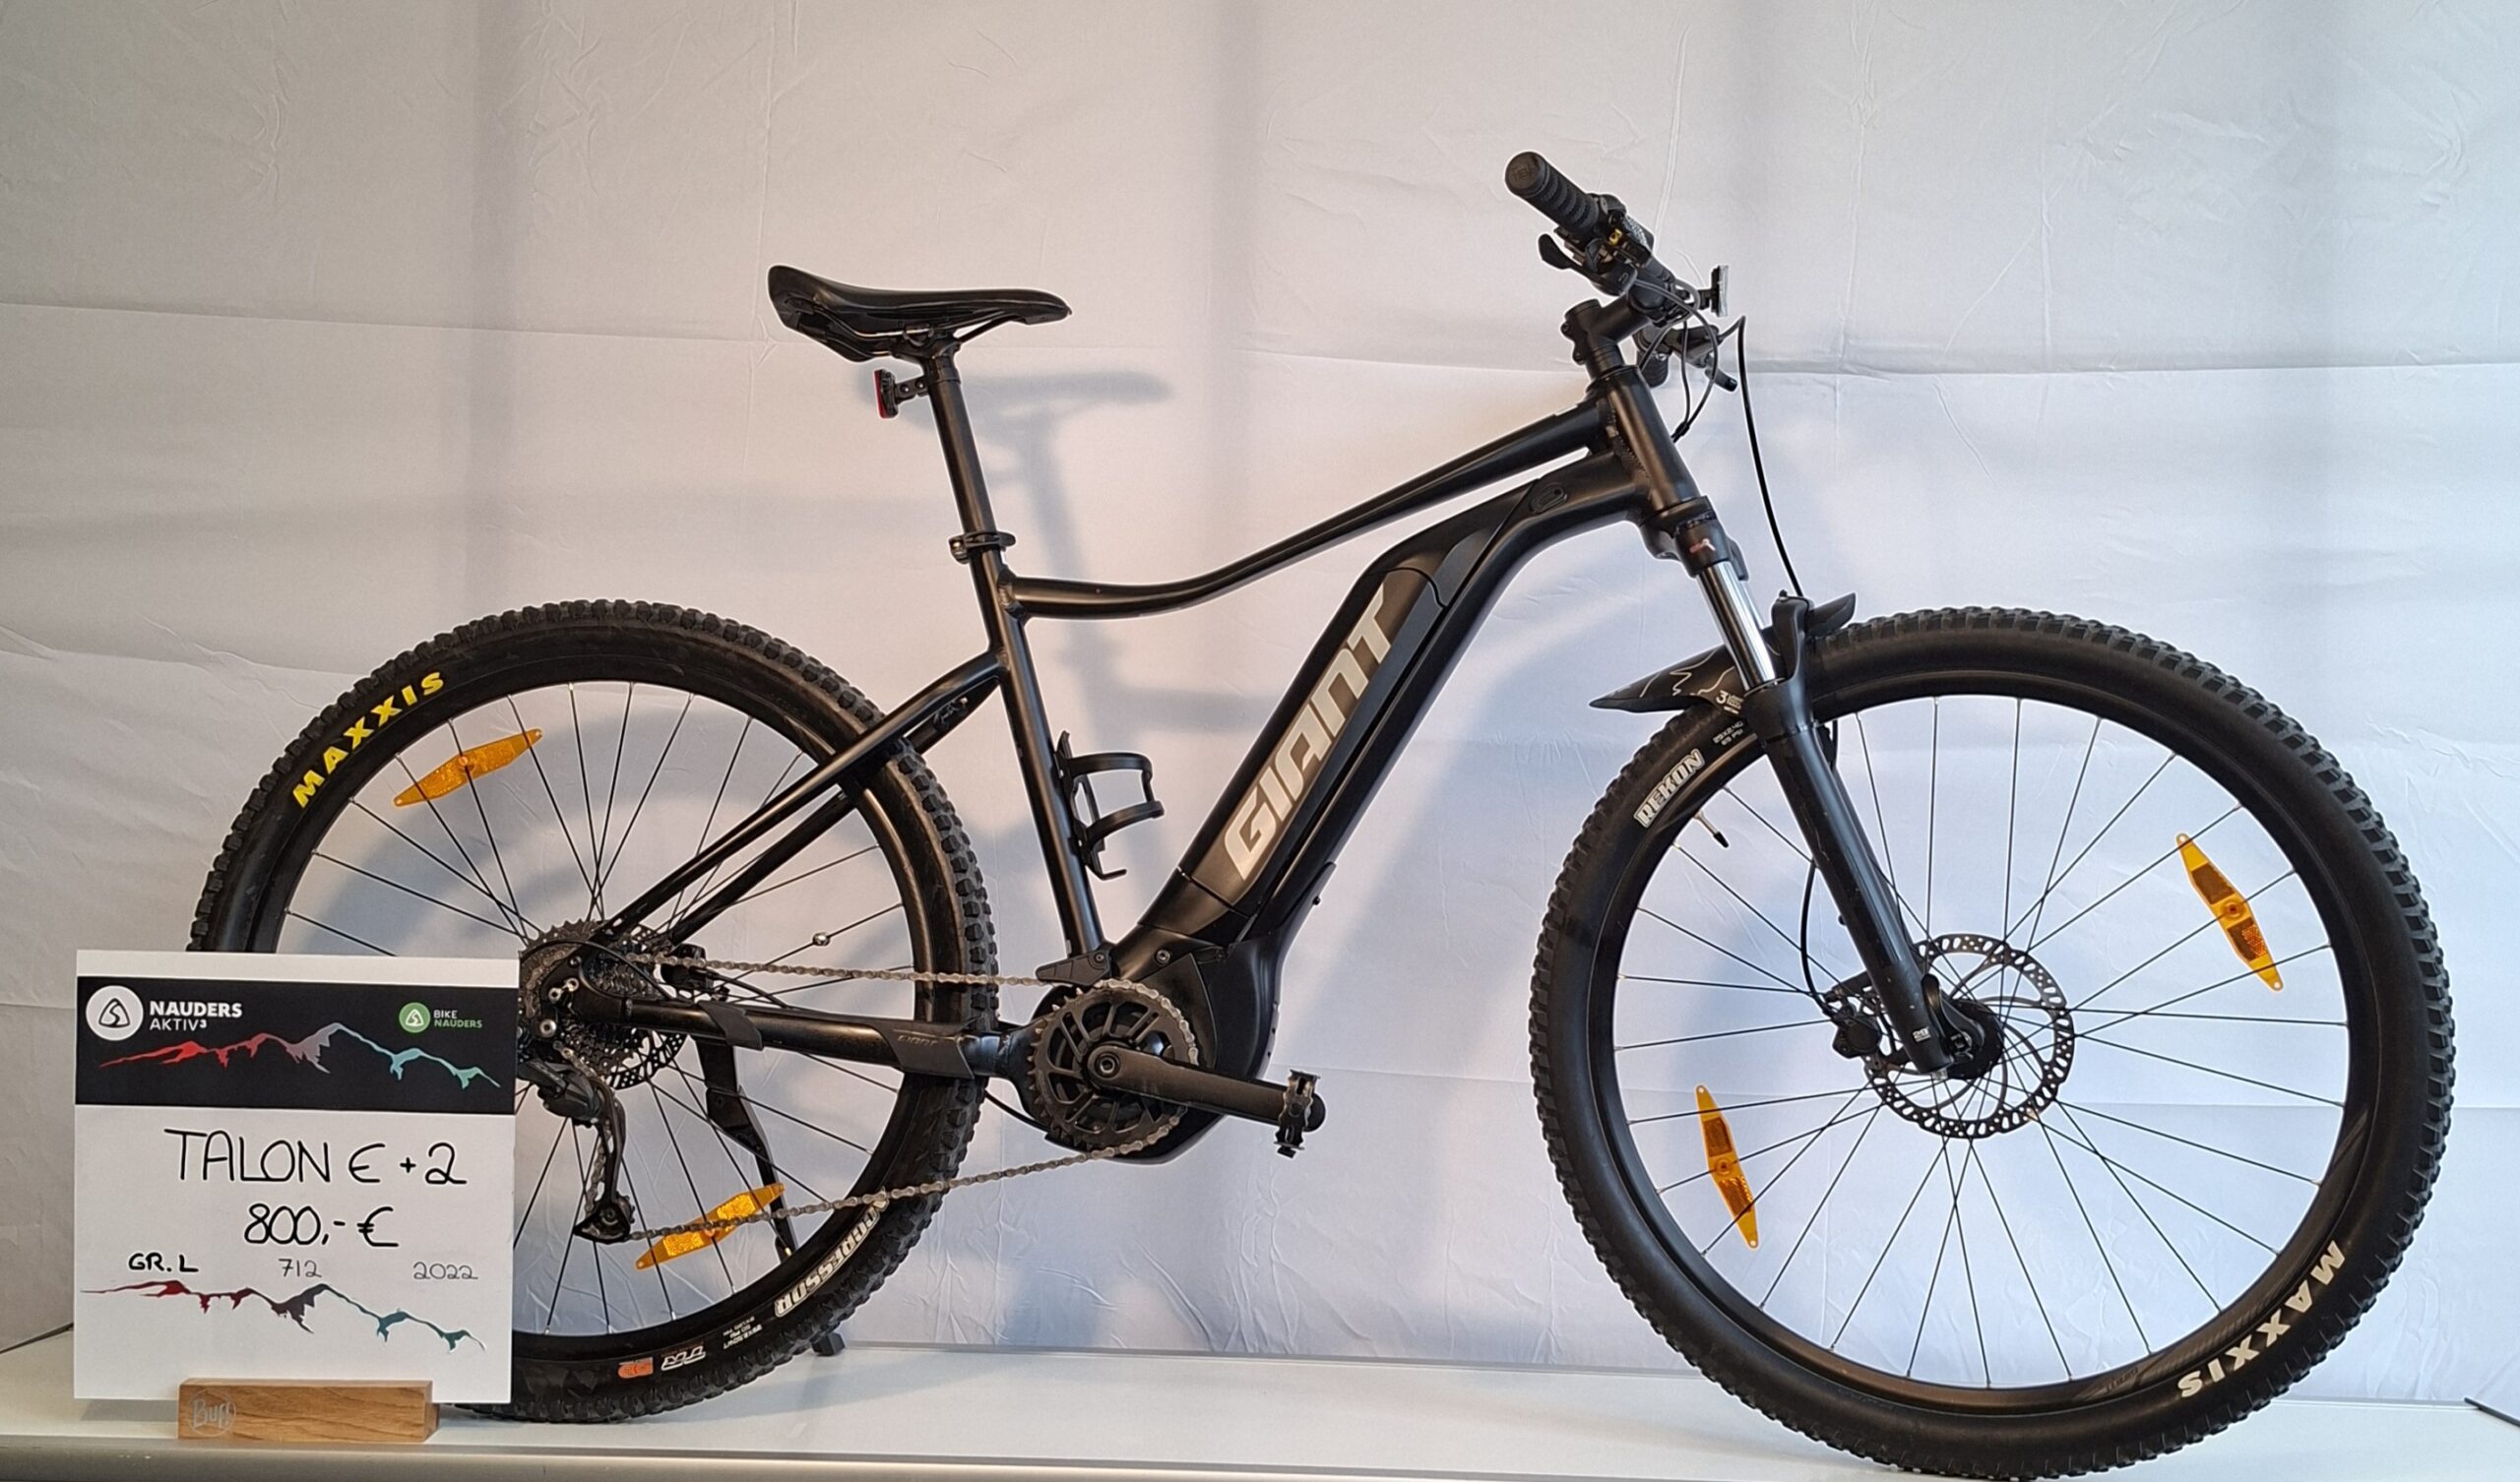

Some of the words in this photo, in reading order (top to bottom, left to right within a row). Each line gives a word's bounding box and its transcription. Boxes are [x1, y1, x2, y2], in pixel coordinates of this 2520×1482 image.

[292, 672, 444, 808] MAXXIS
[1225, 583, 1391, 881] GIANT
[1635, 750, 1705, 827] REKON
[150, 1000, 243, 1019] NAUDERS
[433, 1010, 458, 1019] BIKE
[433, 1019, 483, 1028] NAUDERS
[163, 1129, 332, 1183] TALON
[357, 1205, 400, 1247] €
[278, 1258, 323, 1278] 712
[412, 1261, 479, 1280] 2022
[2176, 1240, 2346, 1398] MAXXIS
